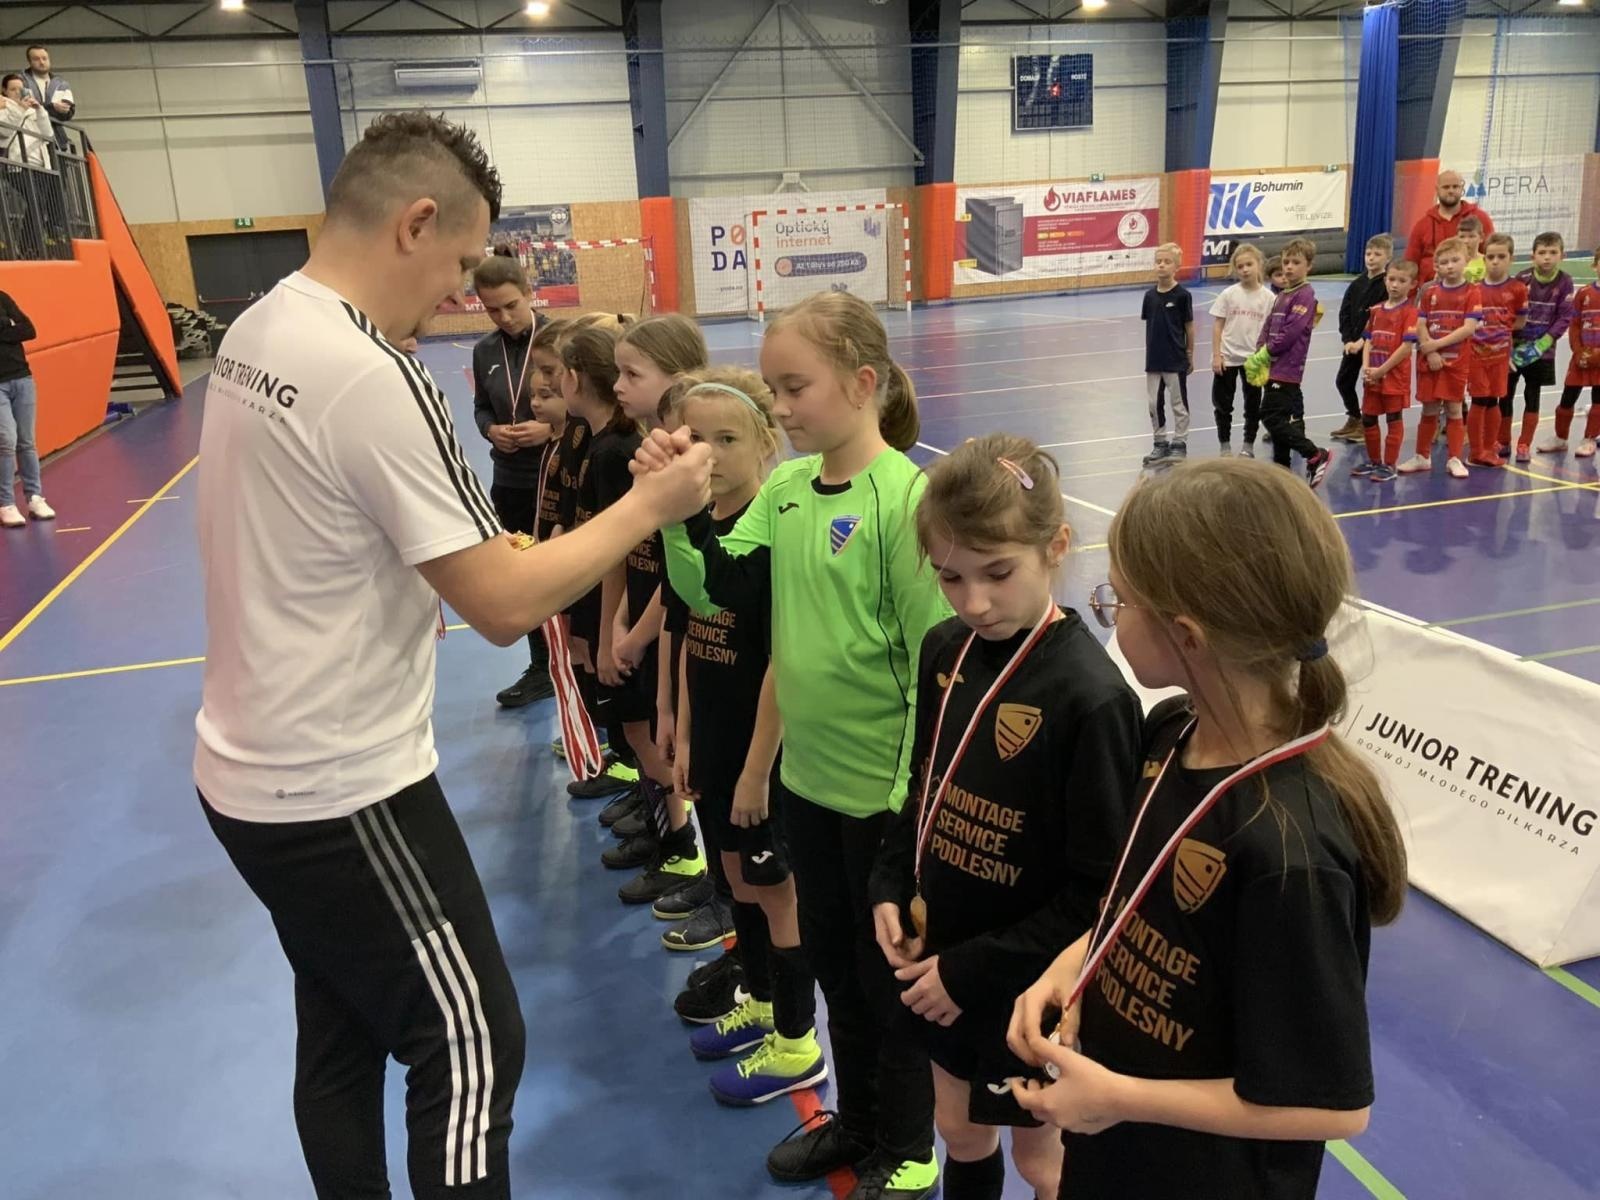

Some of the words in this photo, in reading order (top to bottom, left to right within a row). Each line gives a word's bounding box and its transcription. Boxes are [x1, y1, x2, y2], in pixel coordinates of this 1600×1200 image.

[1061, 189, 1137, 204] VIAFLAMES
[1253, 180, 1303, 193] Bohumín
[775, 219, 830, 236] Optický
[777, 235, 832, 248] internet
[1357, 738, 1411, 769] ROZWÓJ
[1417, 768, 1489, 809] MŁODEGO
[1496, 808, 1580, 856] PIŁKARZA
[1365, 712, 1459, 771] JUNIOR
[1465, 755, 1598, 836] TRENING
[943, 781, 1026, 833] MONTAGE
[937, 809, 1008, 856] SERVICE
[930, 833, 1023, 887] PODLESNY
[1107, 936, 1176, 1009] ERVICE
